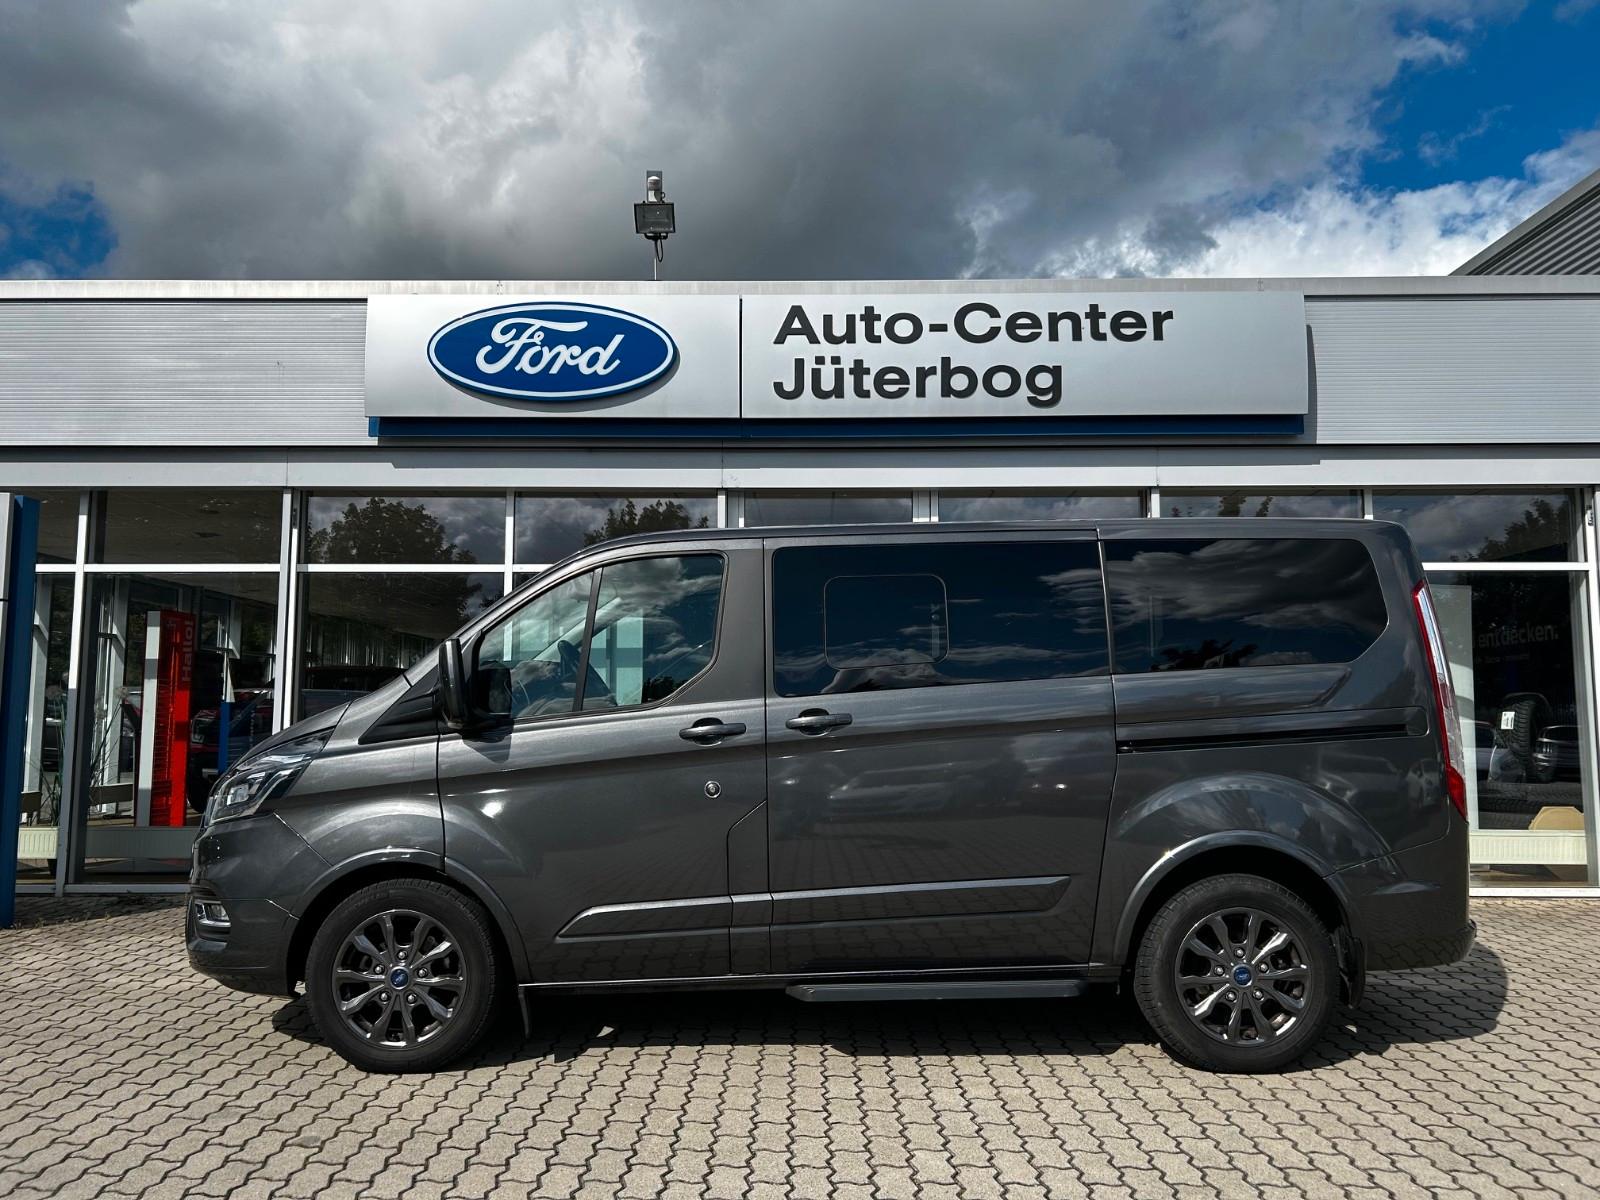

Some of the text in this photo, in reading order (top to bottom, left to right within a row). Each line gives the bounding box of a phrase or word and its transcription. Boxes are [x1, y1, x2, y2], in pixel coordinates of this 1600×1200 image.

[475, 317, 625, 376] Ford
[773, 303, 1174, 344] Auto-Center
[773, 355, 1063, 408] Jüterbog
